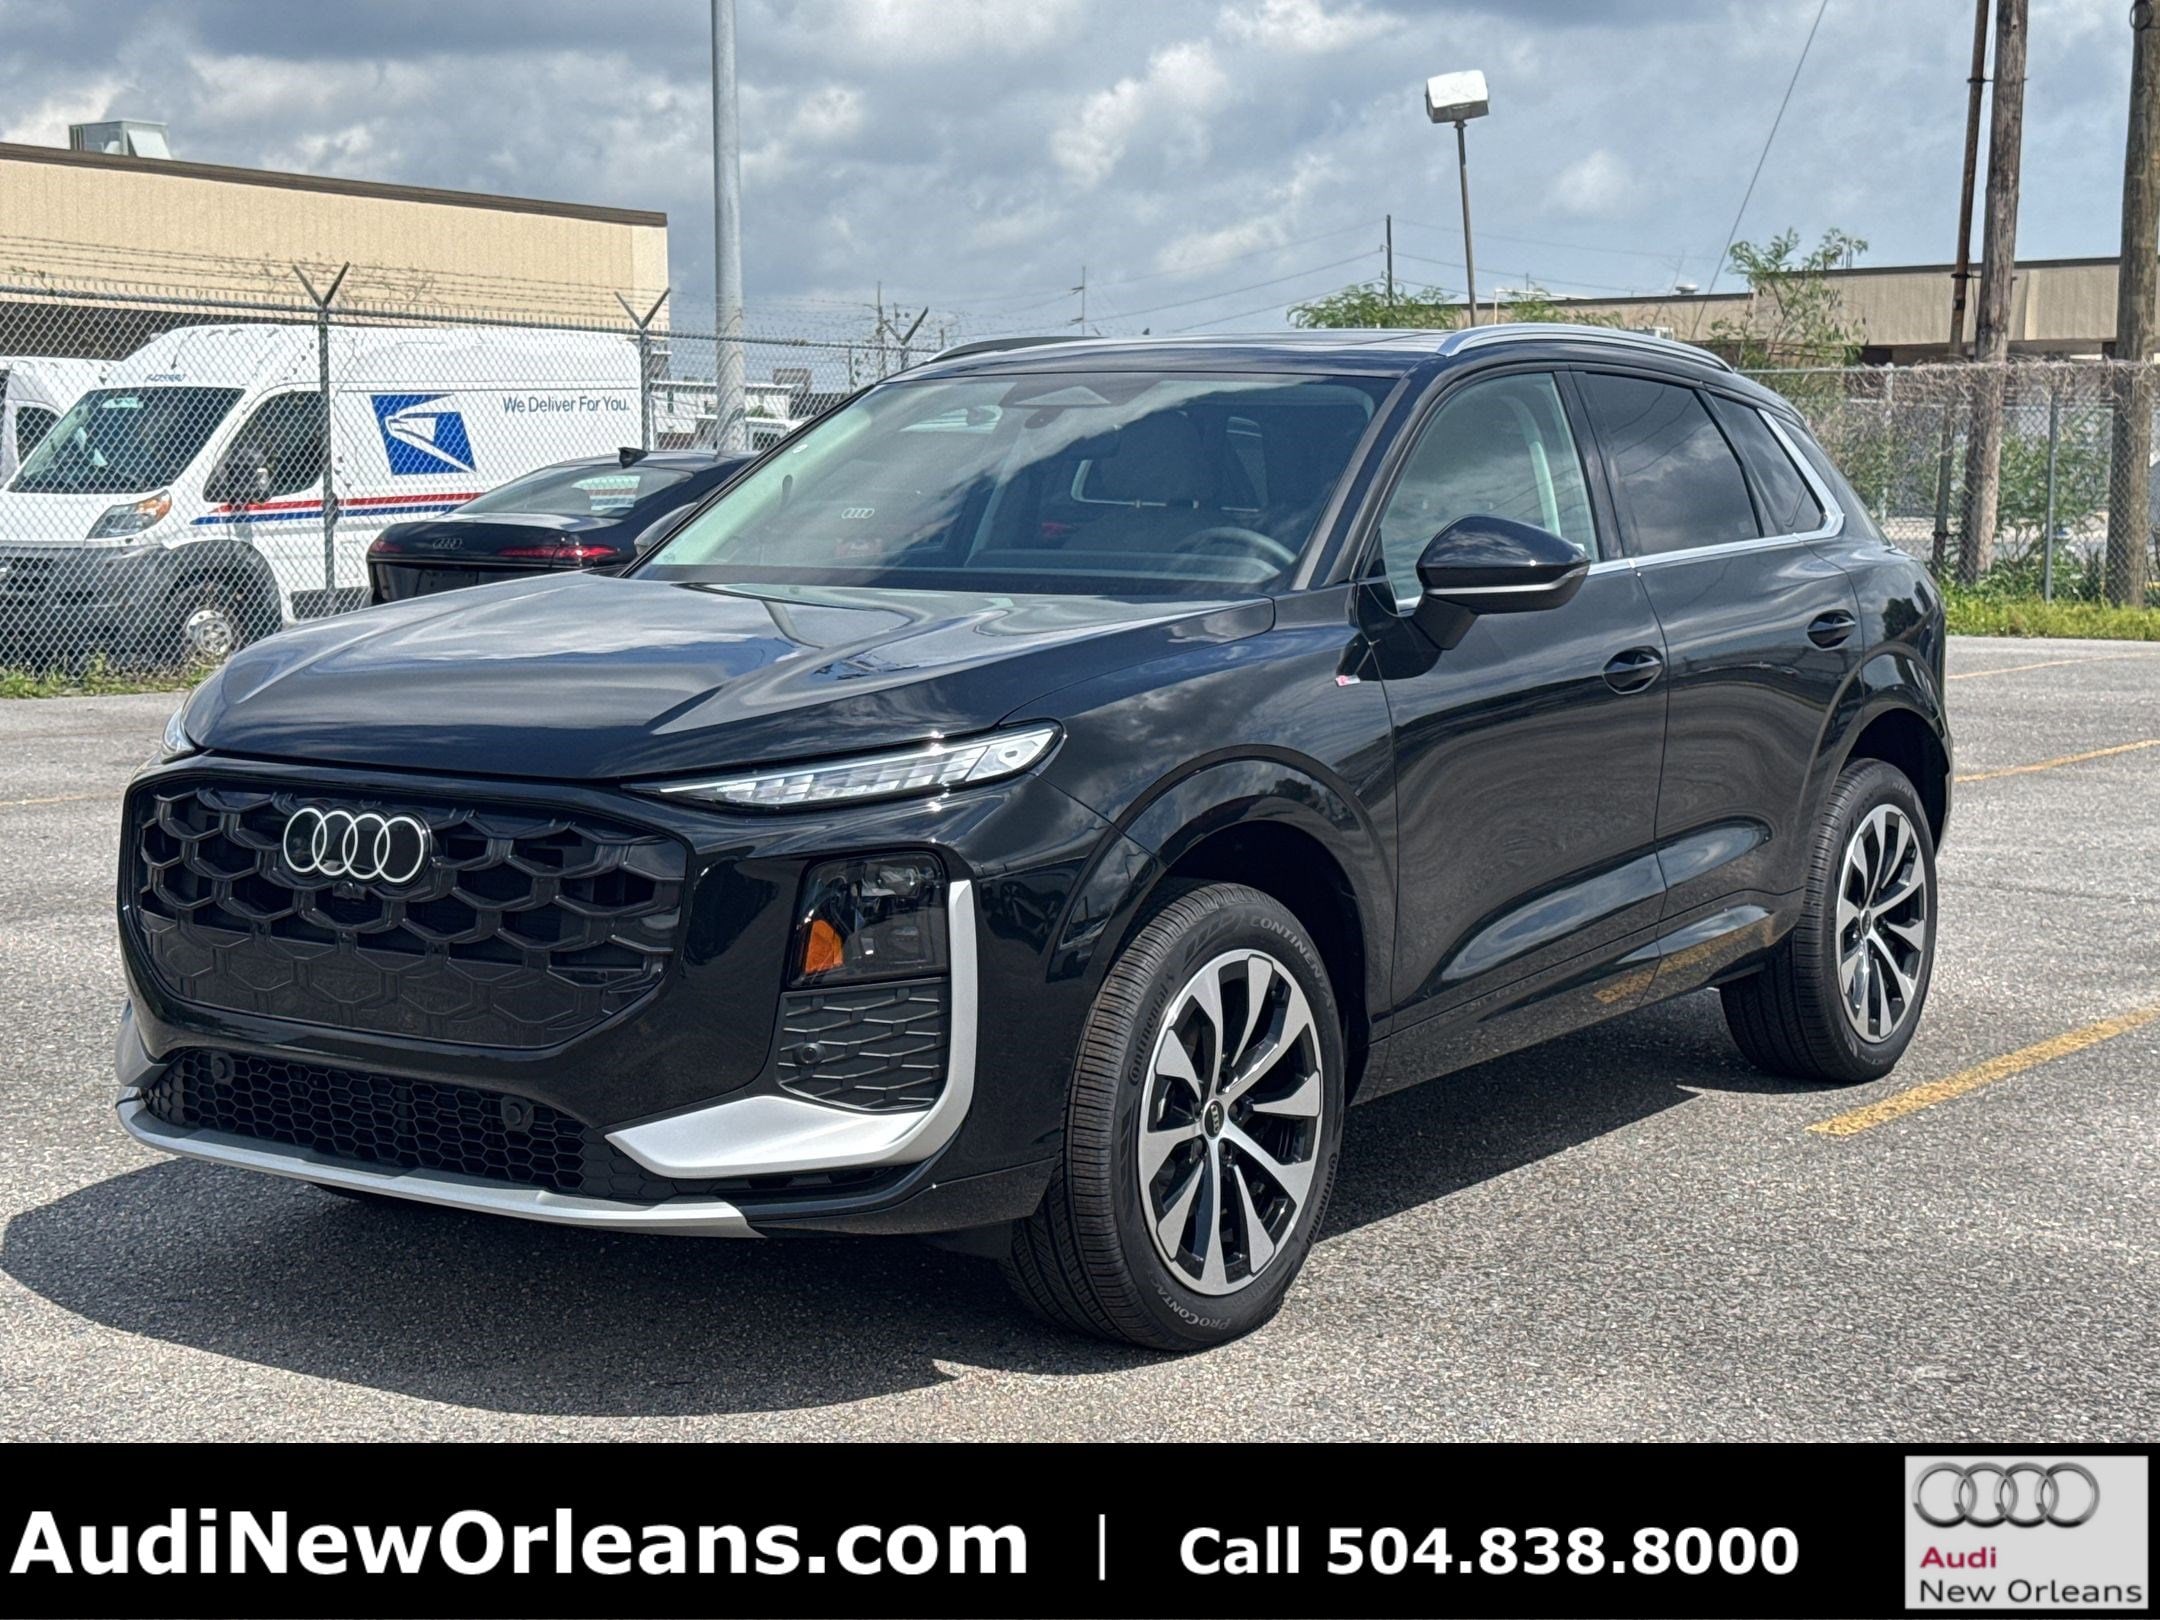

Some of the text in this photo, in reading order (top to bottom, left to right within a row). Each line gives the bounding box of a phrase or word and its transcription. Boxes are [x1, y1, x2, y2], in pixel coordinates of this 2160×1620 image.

[502, 396, 525, 413] We
[528, 396, 576, 412] Deliver
[579, 395, 601, 411] For
